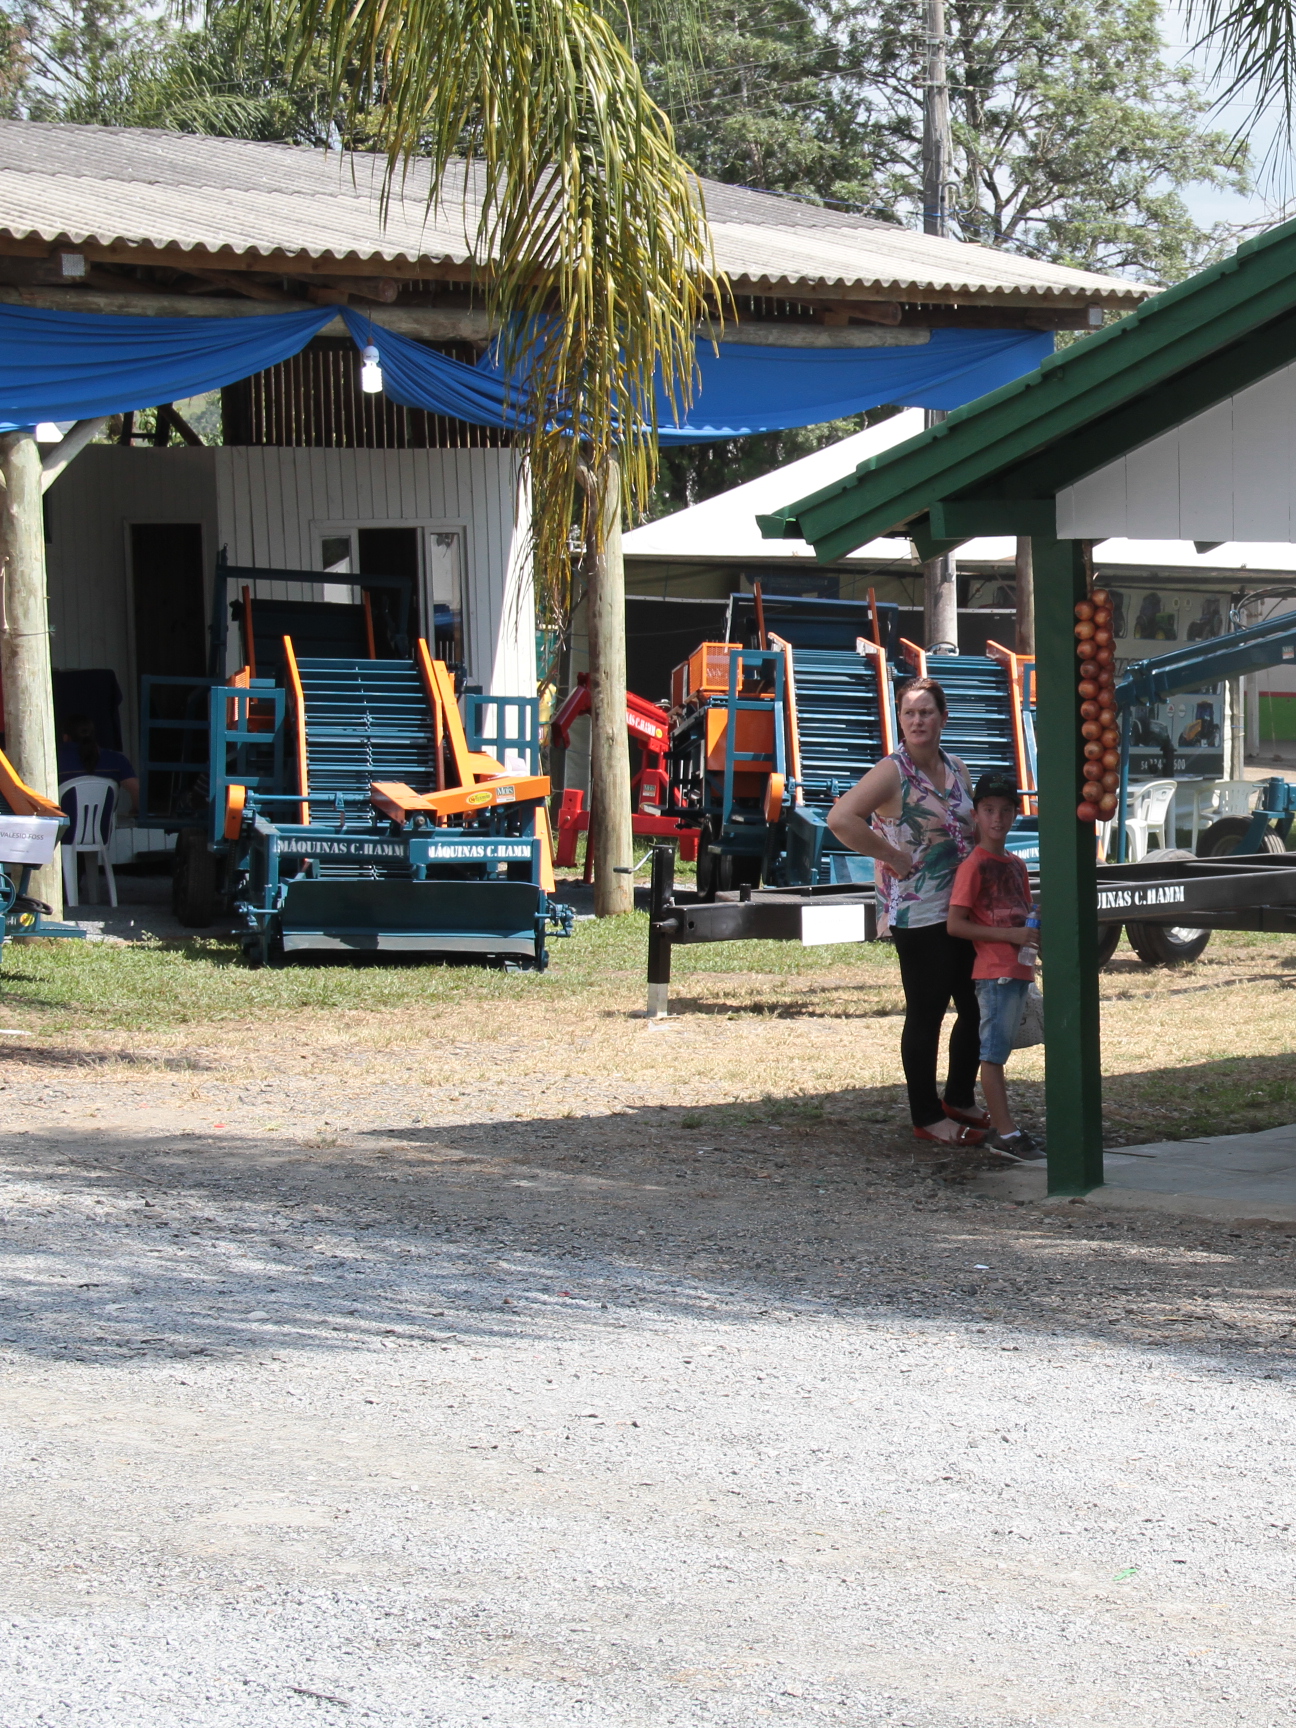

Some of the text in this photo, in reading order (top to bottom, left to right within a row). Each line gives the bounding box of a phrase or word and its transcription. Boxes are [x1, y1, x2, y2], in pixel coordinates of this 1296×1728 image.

[279, 839, 405, 857] MÁQUINAS C.HAMM
[428, 842, 531, 858] MÁQUINAS C.HAMM
[1134, 886, 1185, 906] C.HAMM
